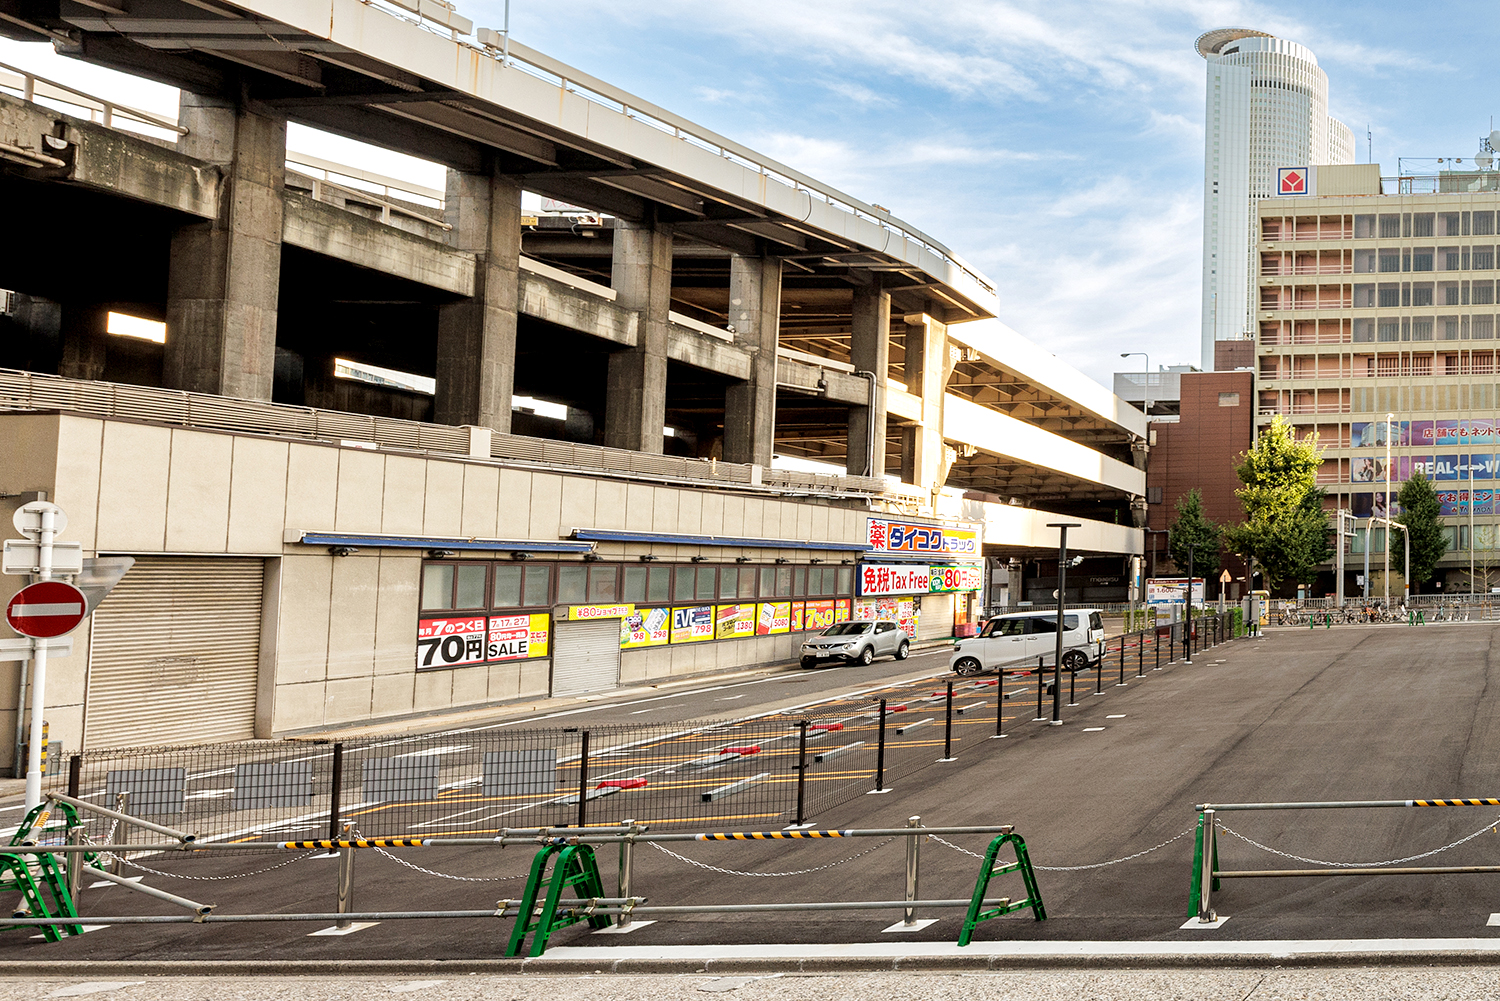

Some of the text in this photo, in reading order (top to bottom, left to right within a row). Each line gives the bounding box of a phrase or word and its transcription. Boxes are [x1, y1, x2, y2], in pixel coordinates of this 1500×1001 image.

[1414, 462, 1454, 475] REAL
[870, 520, 885, 549] 薬
[864, 567, 889, 593] 免税
[891, 571, 907, 589] Tax
[909, 571, 928, 589] Free
[674, 609, 696, 628] EVE
[418, 635, 482, 666] 70円
[488, 641, 527, 657] SALE
